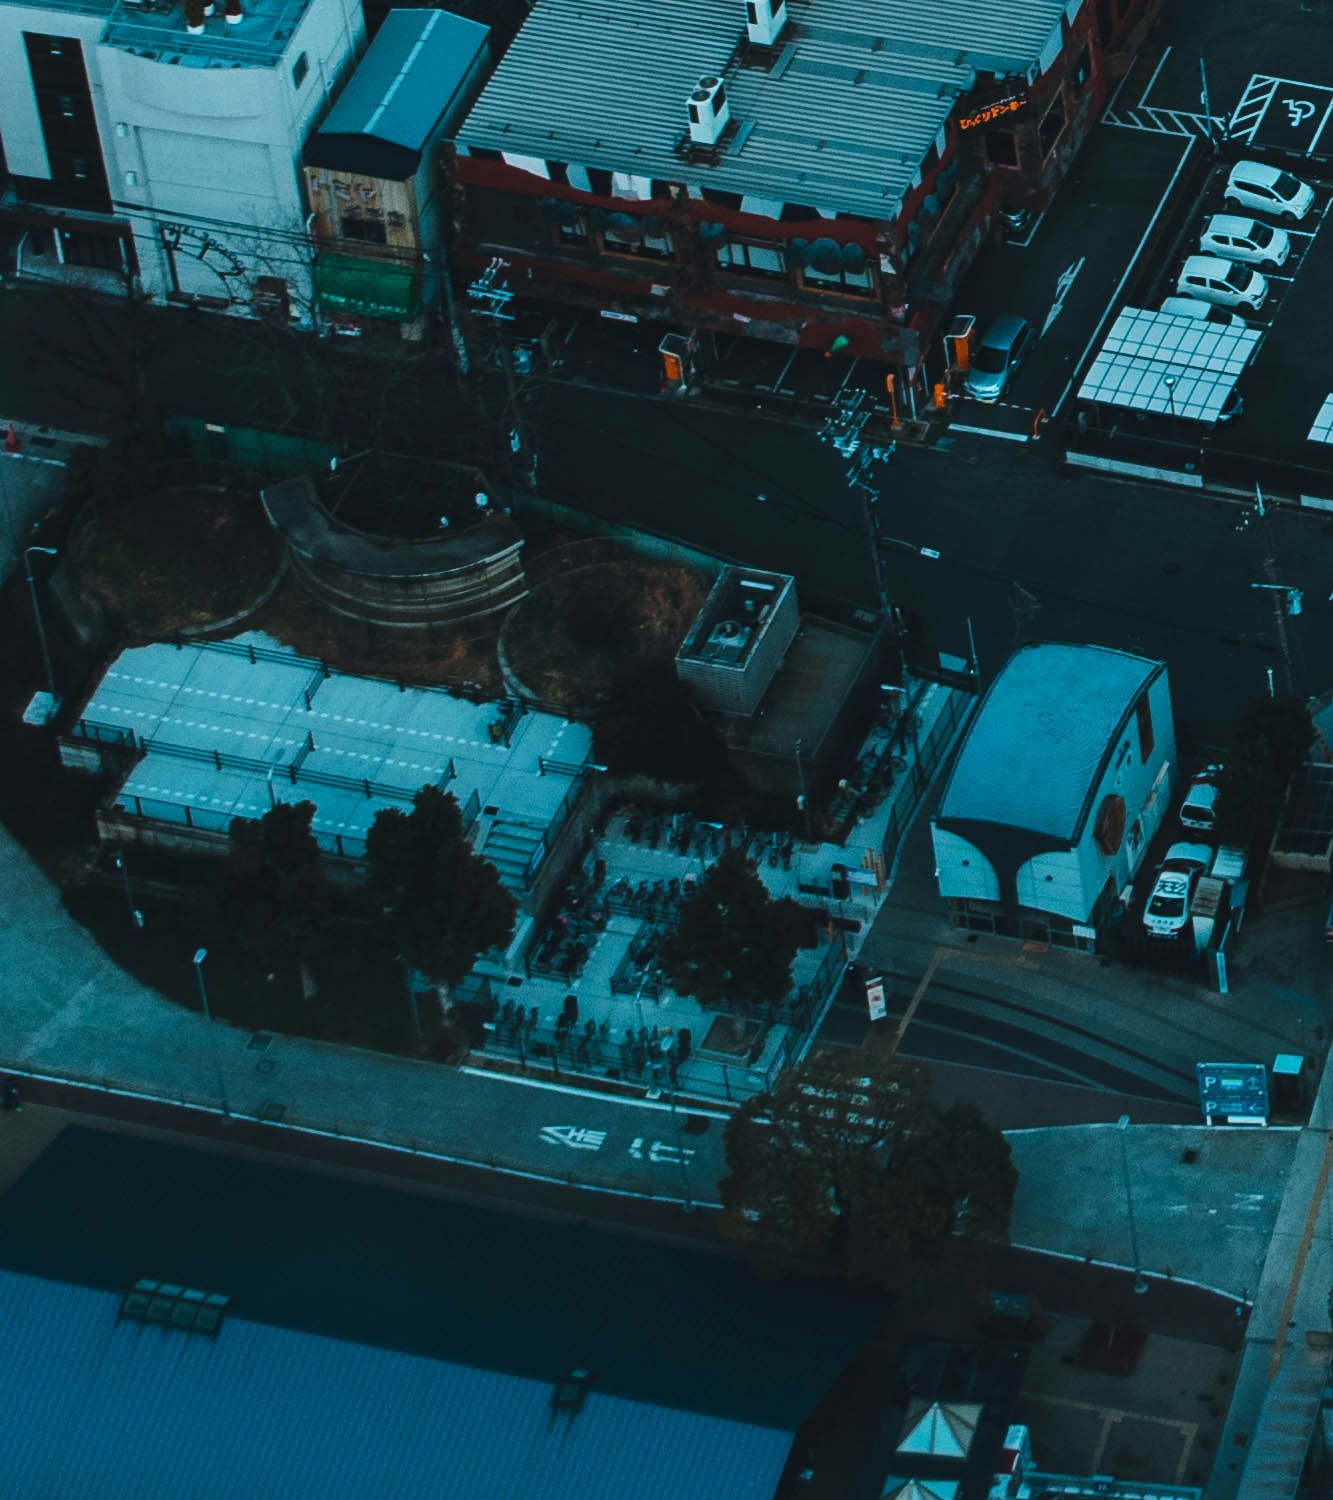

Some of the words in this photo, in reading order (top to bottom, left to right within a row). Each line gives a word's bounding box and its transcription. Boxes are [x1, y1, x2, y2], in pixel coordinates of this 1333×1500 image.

[959, 99, 1028, 130] びっくりドンキー
